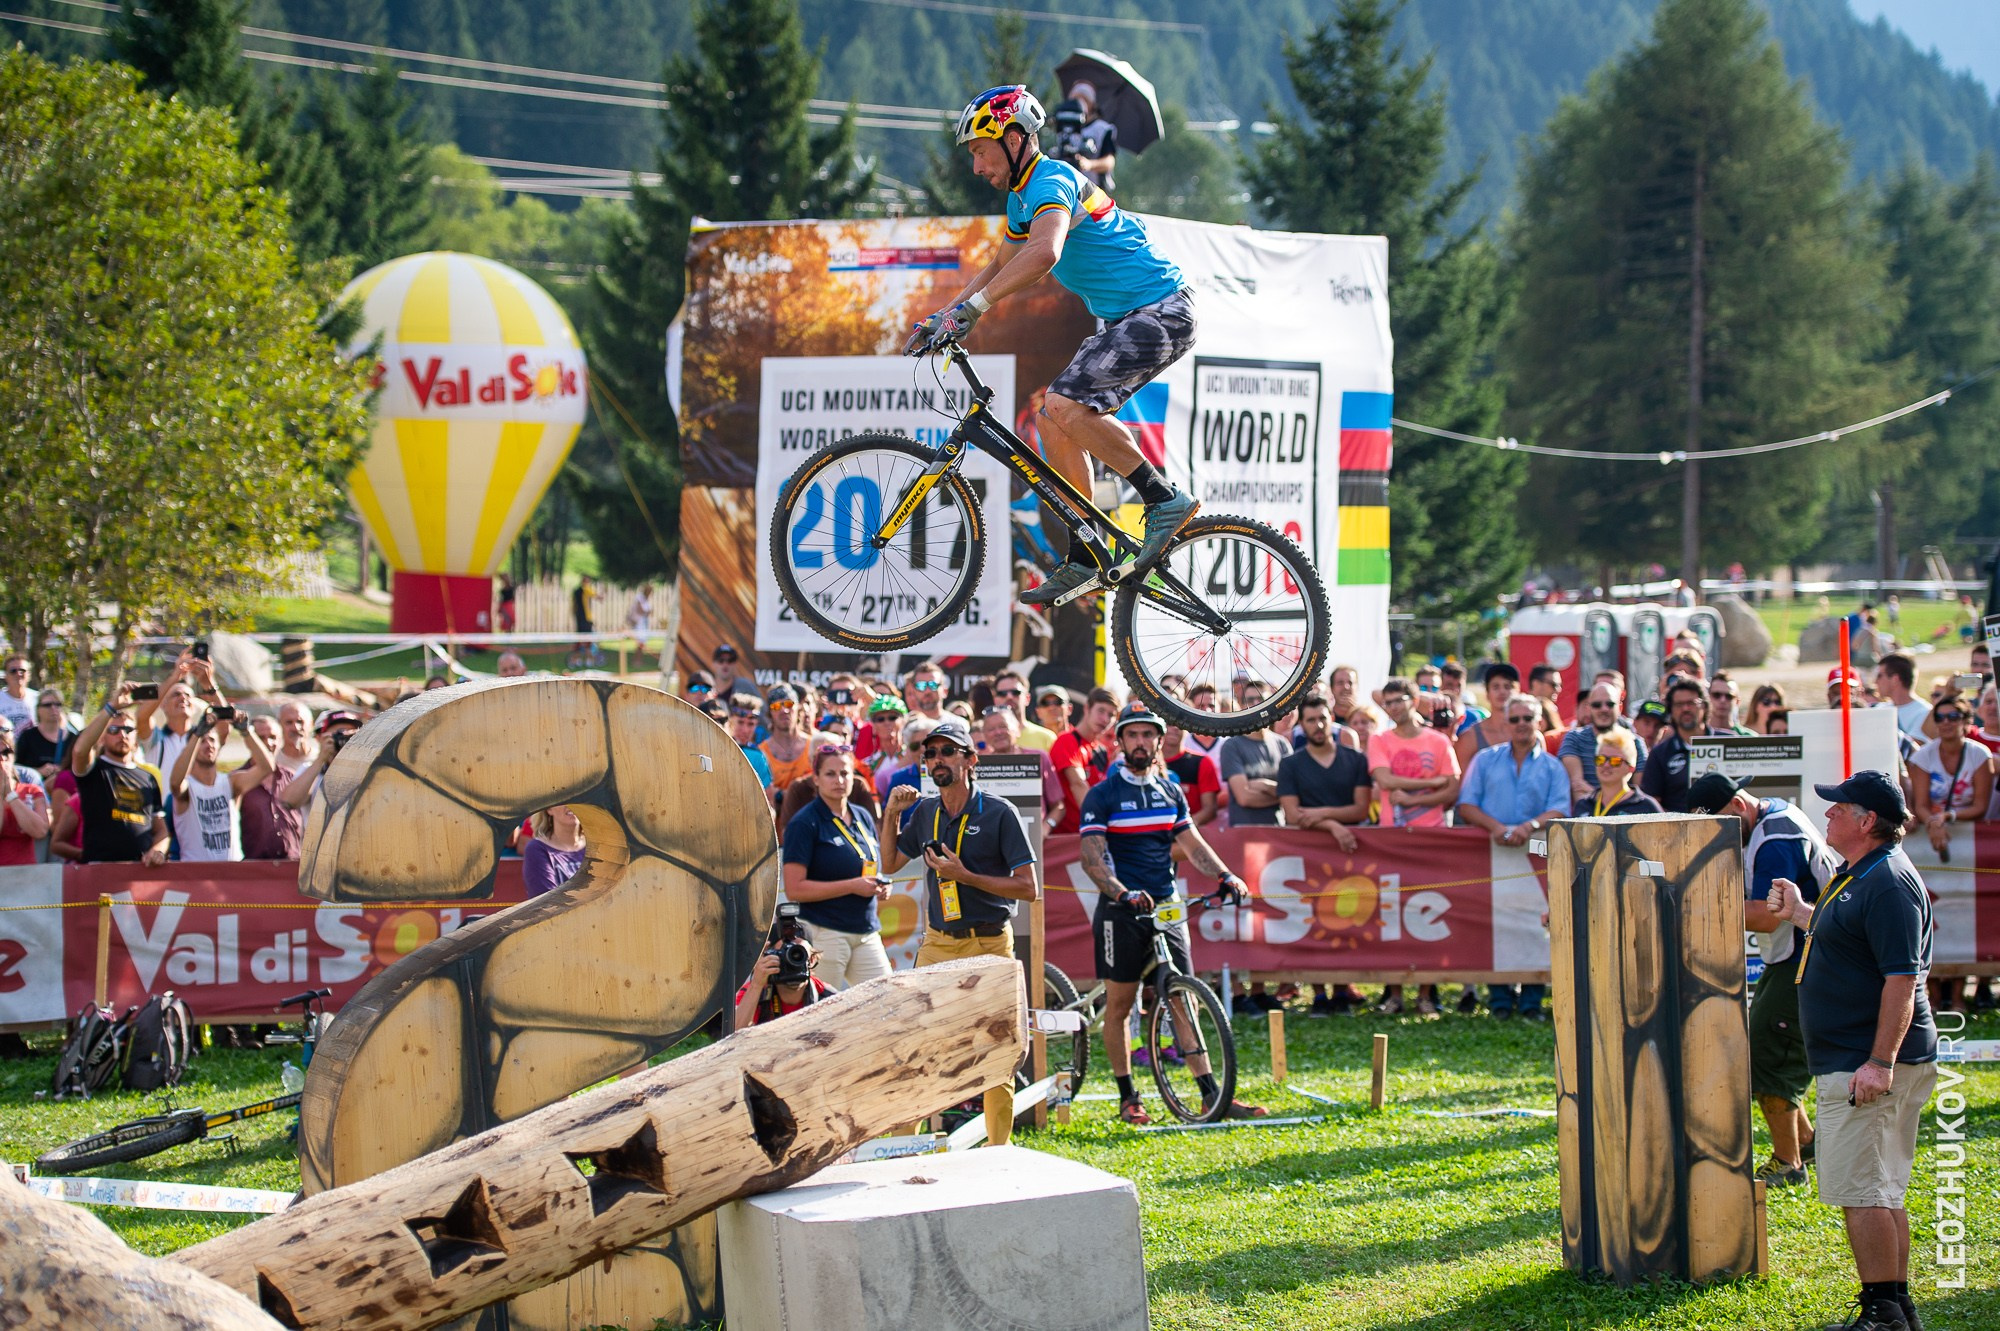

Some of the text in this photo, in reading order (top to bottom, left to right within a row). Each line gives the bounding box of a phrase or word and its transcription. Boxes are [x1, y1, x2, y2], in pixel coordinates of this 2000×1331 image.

[402, 357, 471, 410] Val
[478, 376, 505, 403] di
[1206, 374, 1309, 397] UCI MOUNTAIN BIKE
[781, 389, 815, 411] UCI
[823, 388, 935, 411] MOUNTAIN
[1203, 409, 1308, 463] WORLD
[1204, 481, 1304, 504] CHAMPIONSHIPS
[778, 475, 985, 571] 2017
[1213, 524, 1256, 535] KAISER
[926, 597, 990, 626] AG.
[754, 668, 783, 687] VAL
[1696, 747, 1721, 759] UCI
[1166, 910, 1173, 921] 5
[110, 889, 239, 994] Val
[250, 929, 308, 985] di
